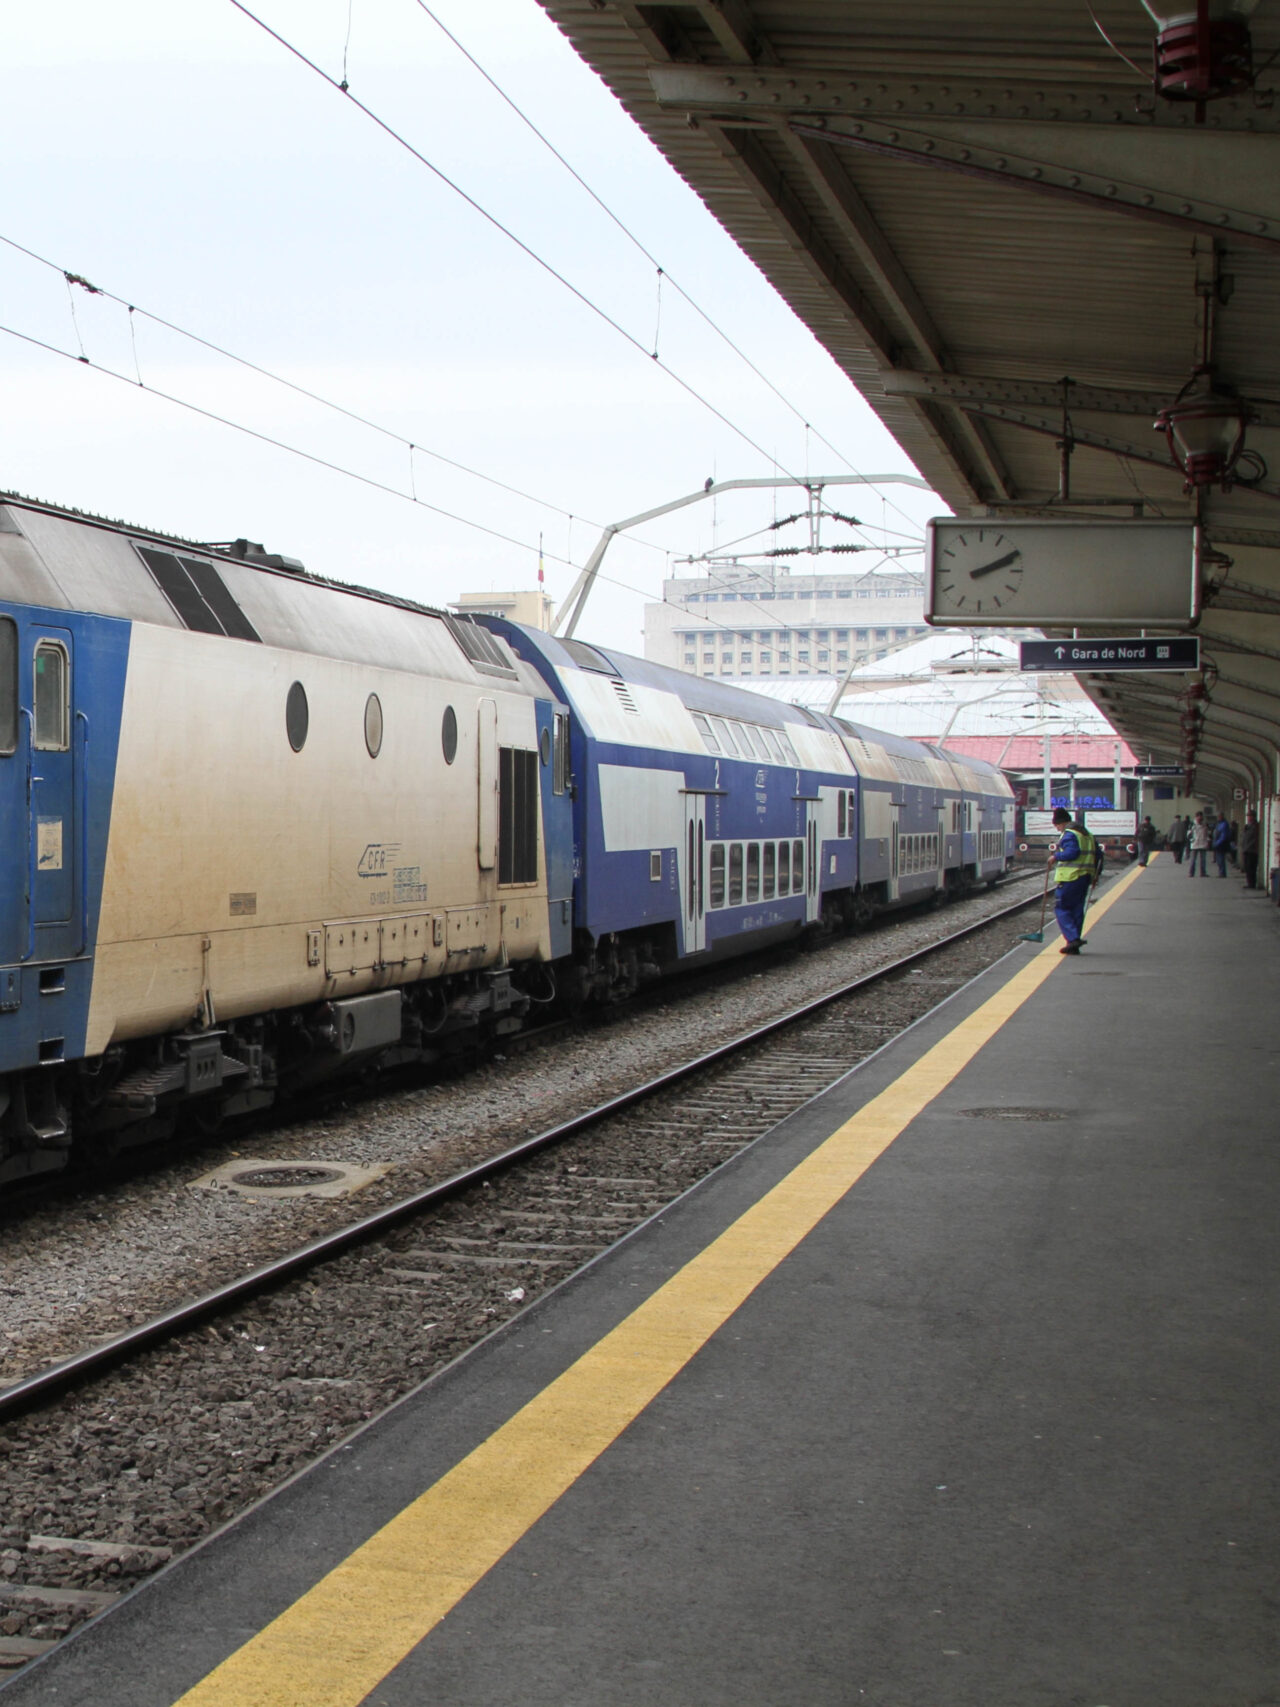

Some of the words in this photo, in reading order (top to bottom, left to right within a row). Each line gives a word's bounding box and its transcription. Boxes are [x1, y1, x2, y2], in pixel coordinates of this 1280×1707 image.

[1071, 648, 1098, 659] Gara
[1101, 648, 1115, 659] de
[1118, 647, 1146, 659] Nord
[368, 850, 386, 870] CFR
